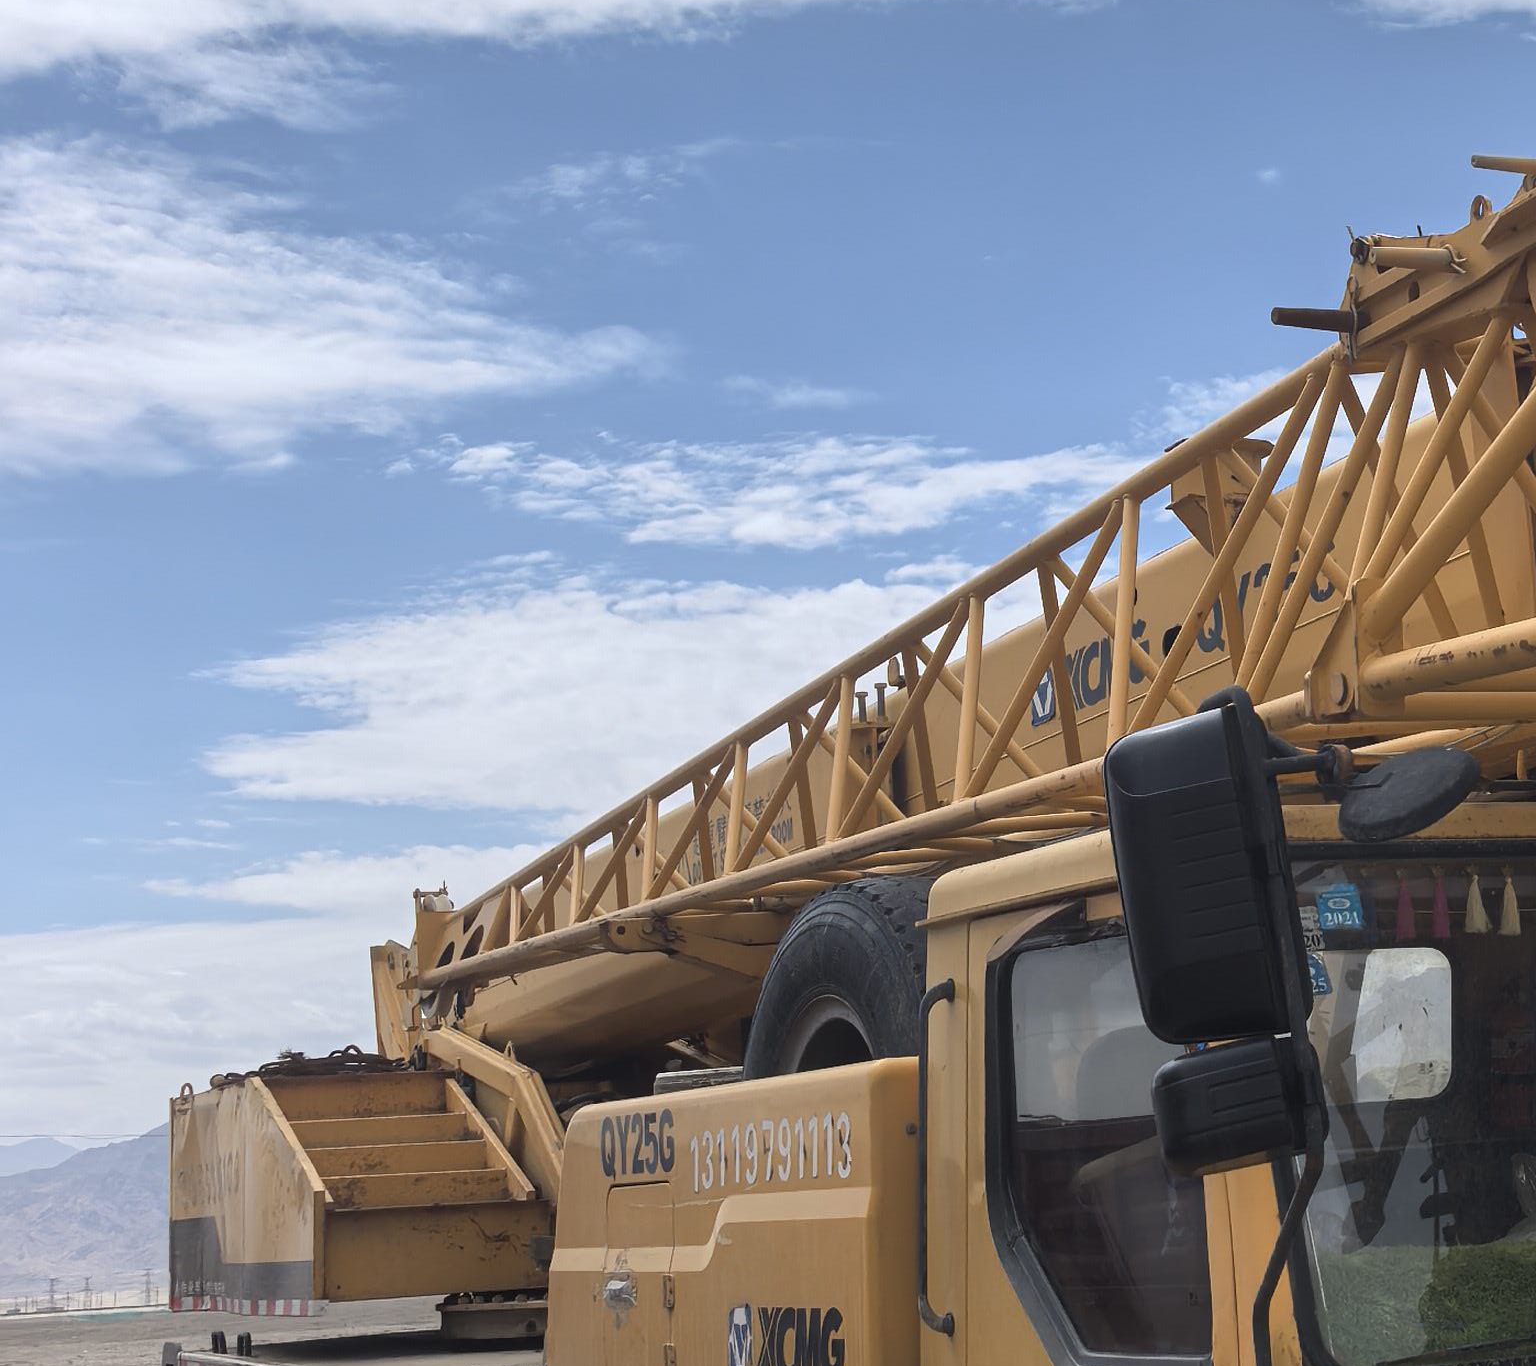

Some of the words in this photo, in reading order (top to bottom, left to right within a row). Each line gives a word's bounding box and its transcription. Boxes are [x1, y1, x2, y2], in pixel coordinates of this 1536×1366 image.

[1323, 910, 1361, 926] 2021
[601, 1108, 675, 1179] QY25G
[690, 1111, 853, 1194] 13119791113
